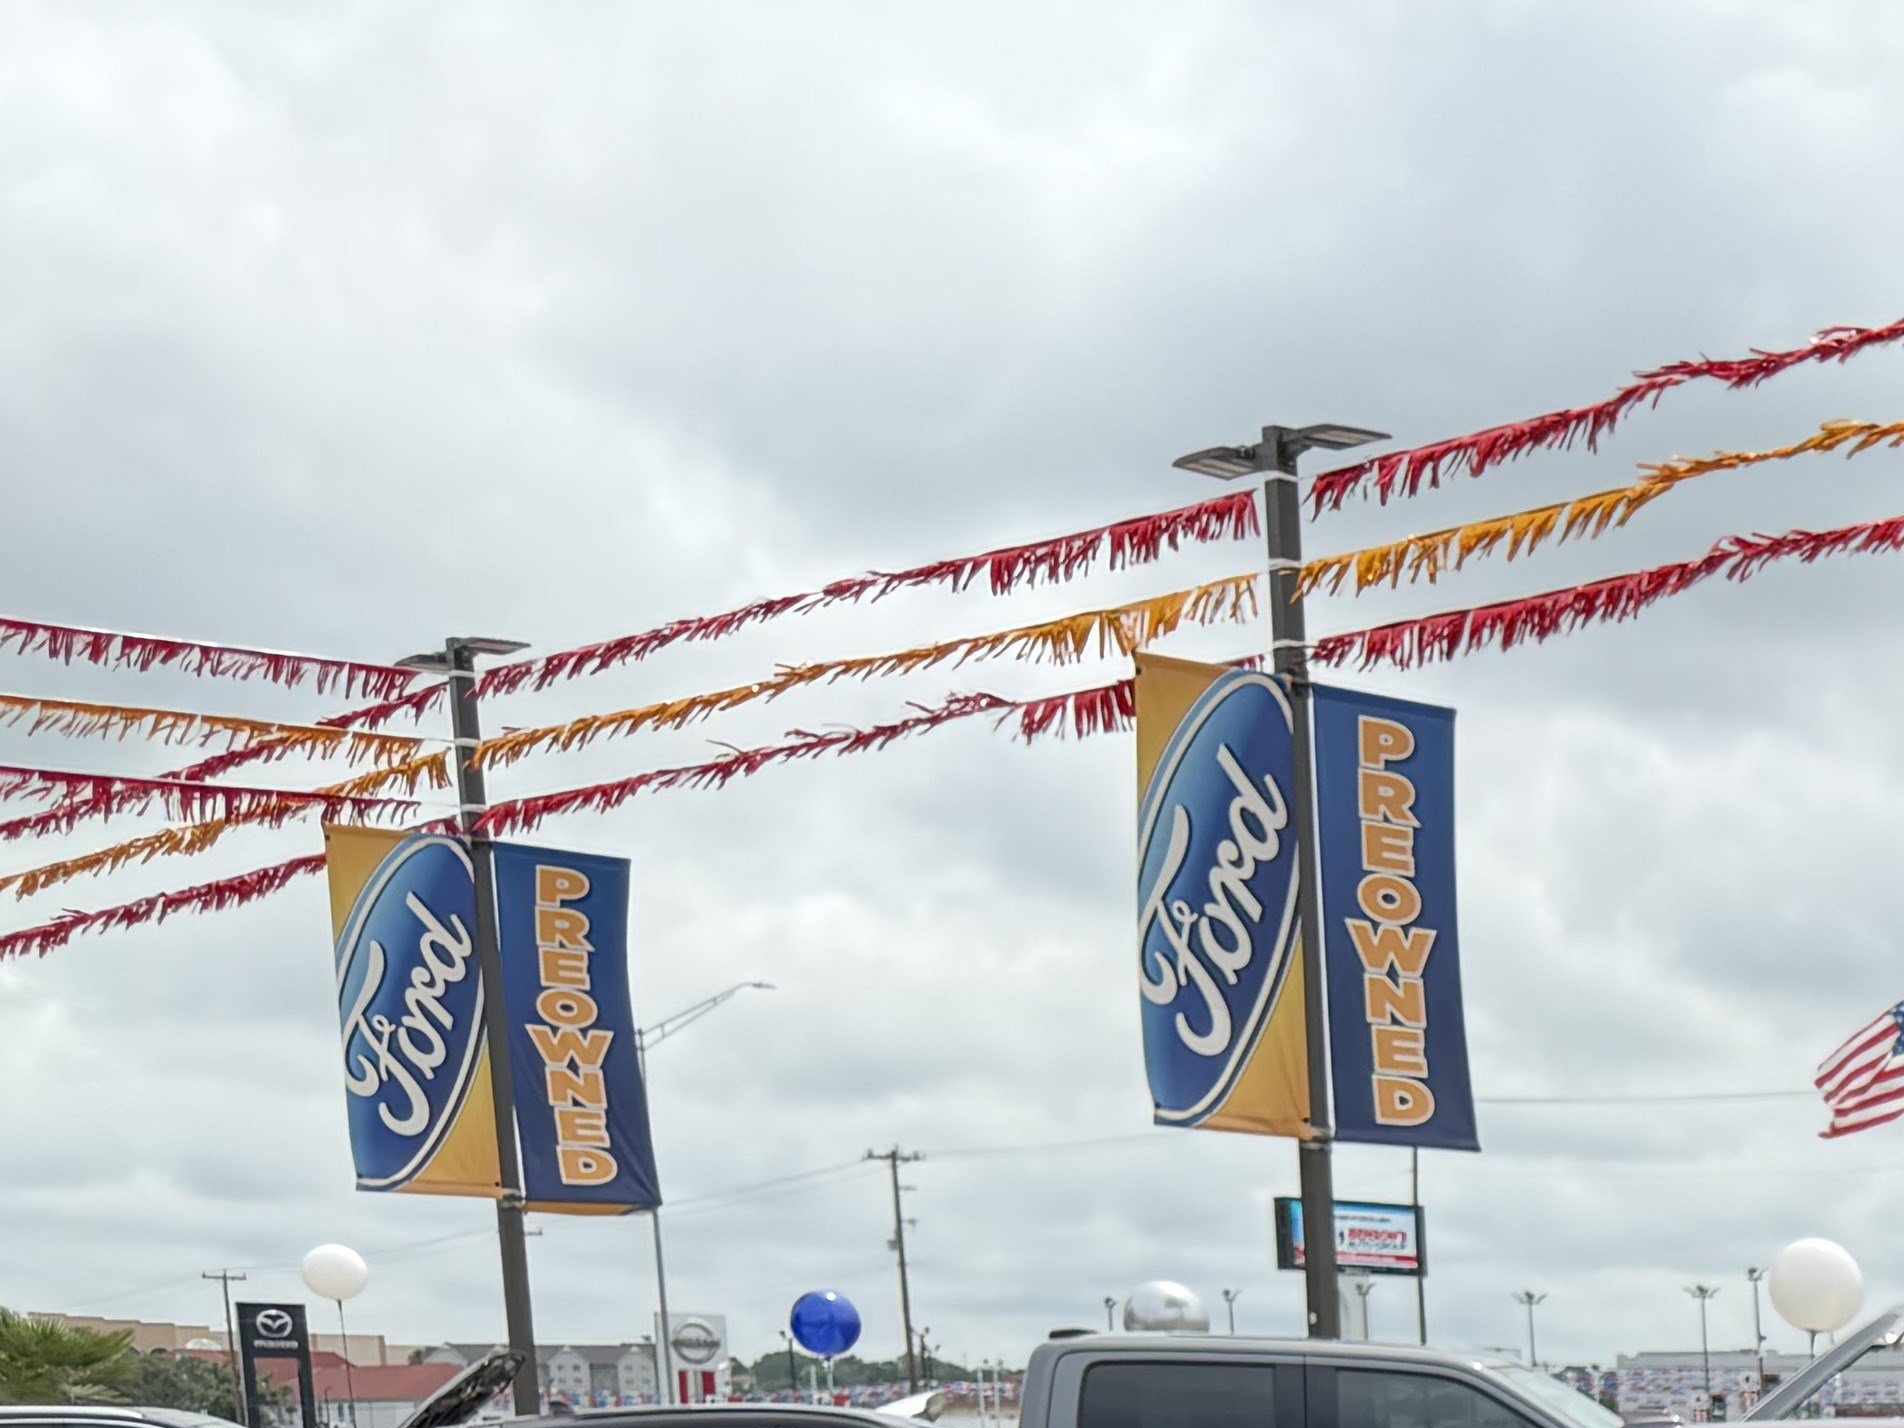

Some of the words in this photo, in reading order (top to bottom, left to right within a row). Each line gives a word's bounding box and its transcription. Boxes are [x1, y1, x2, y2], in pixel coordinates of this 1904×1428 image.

[344, 890, 473, 1138] Ford
[524, 863, 619, 1187] PREOWNED
[1140, 742, 1289, 1057] Ford
[1344, 714, 1438, 1128] PREOWNED
